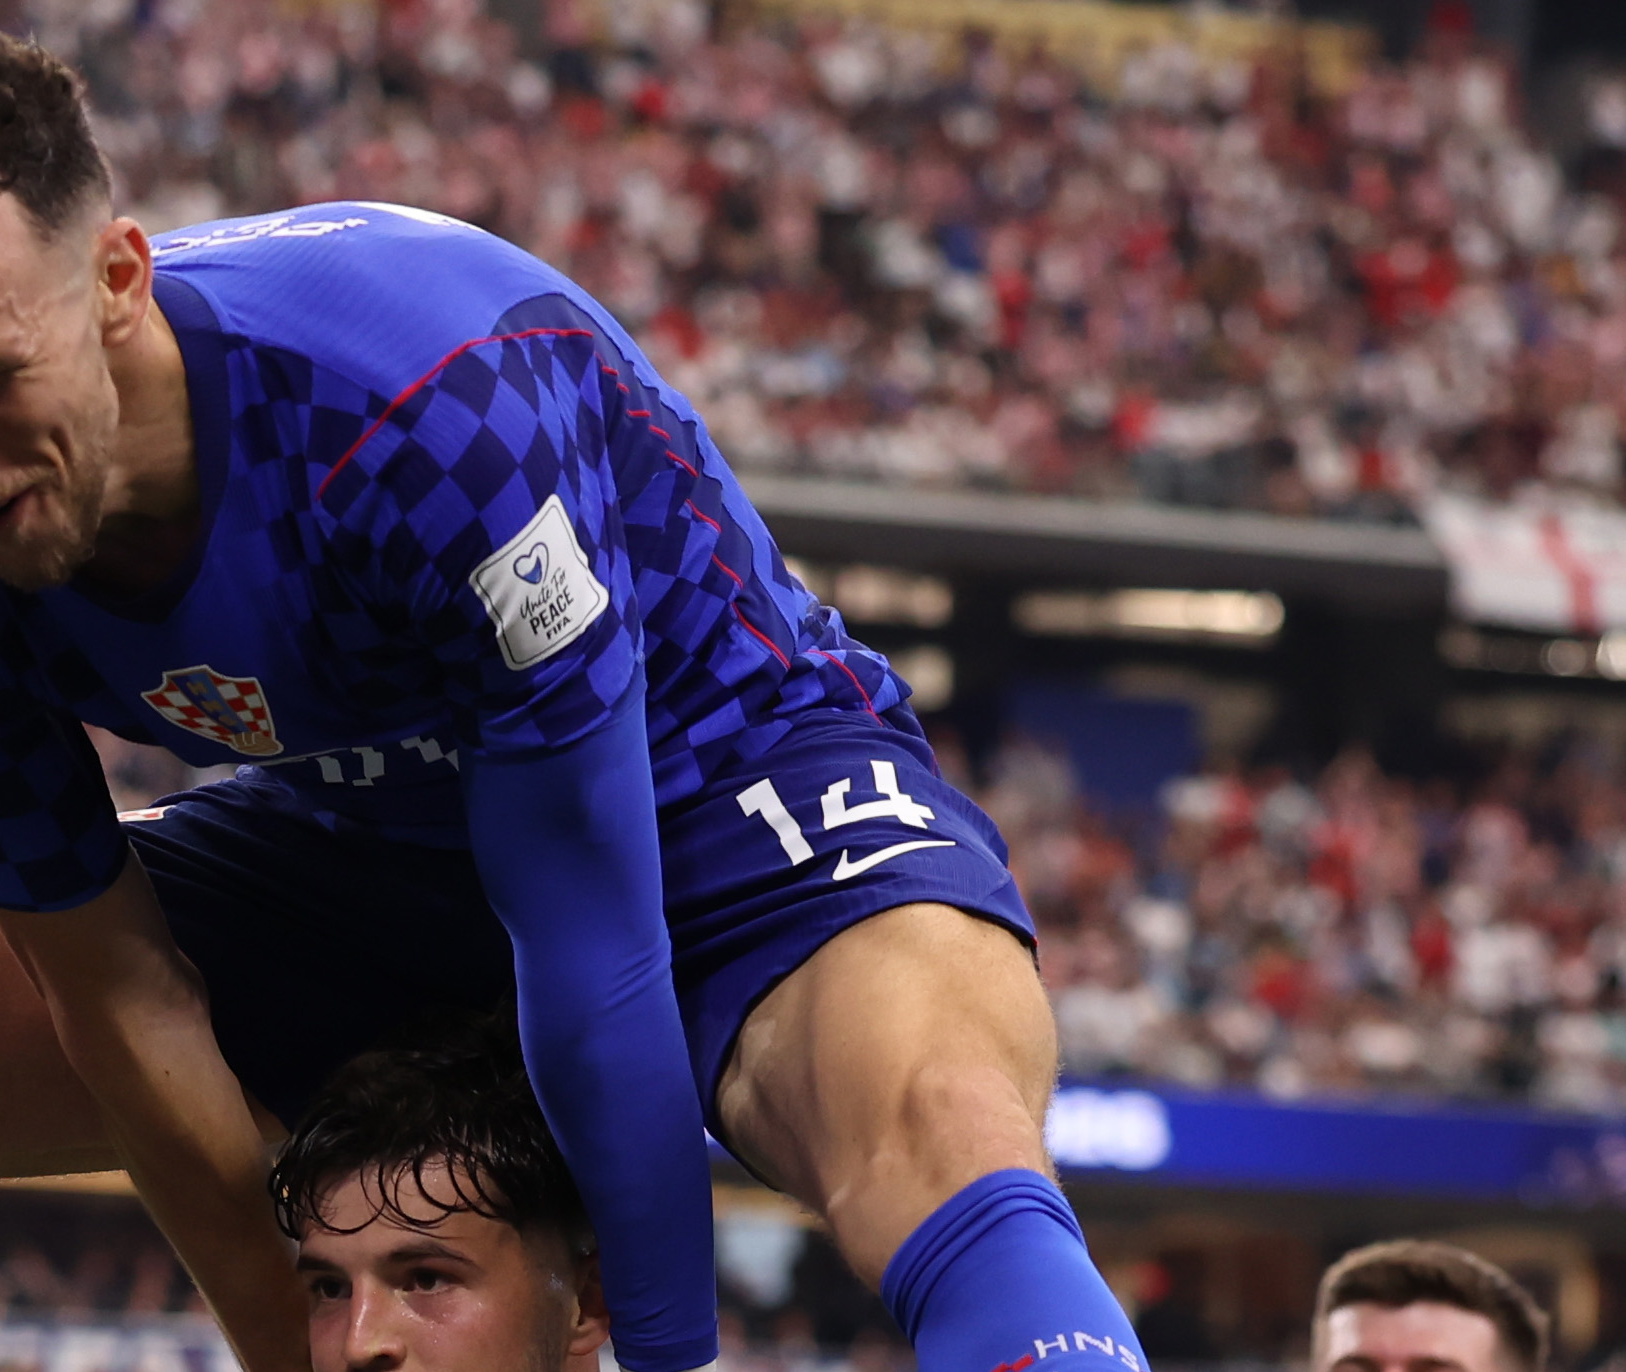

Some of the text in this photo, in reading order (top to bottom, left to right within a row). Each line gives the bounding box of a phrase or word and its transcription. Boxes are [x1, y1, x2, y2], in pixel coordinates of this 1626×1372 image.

[520, 584, 554, 619] Unite
[529, 586, 575, 636] PEACE
[545, 618, 571, 641] FIFA
[736, 760, 936, 866] 14
[1034, 1331, 1140, 1372] HNS
